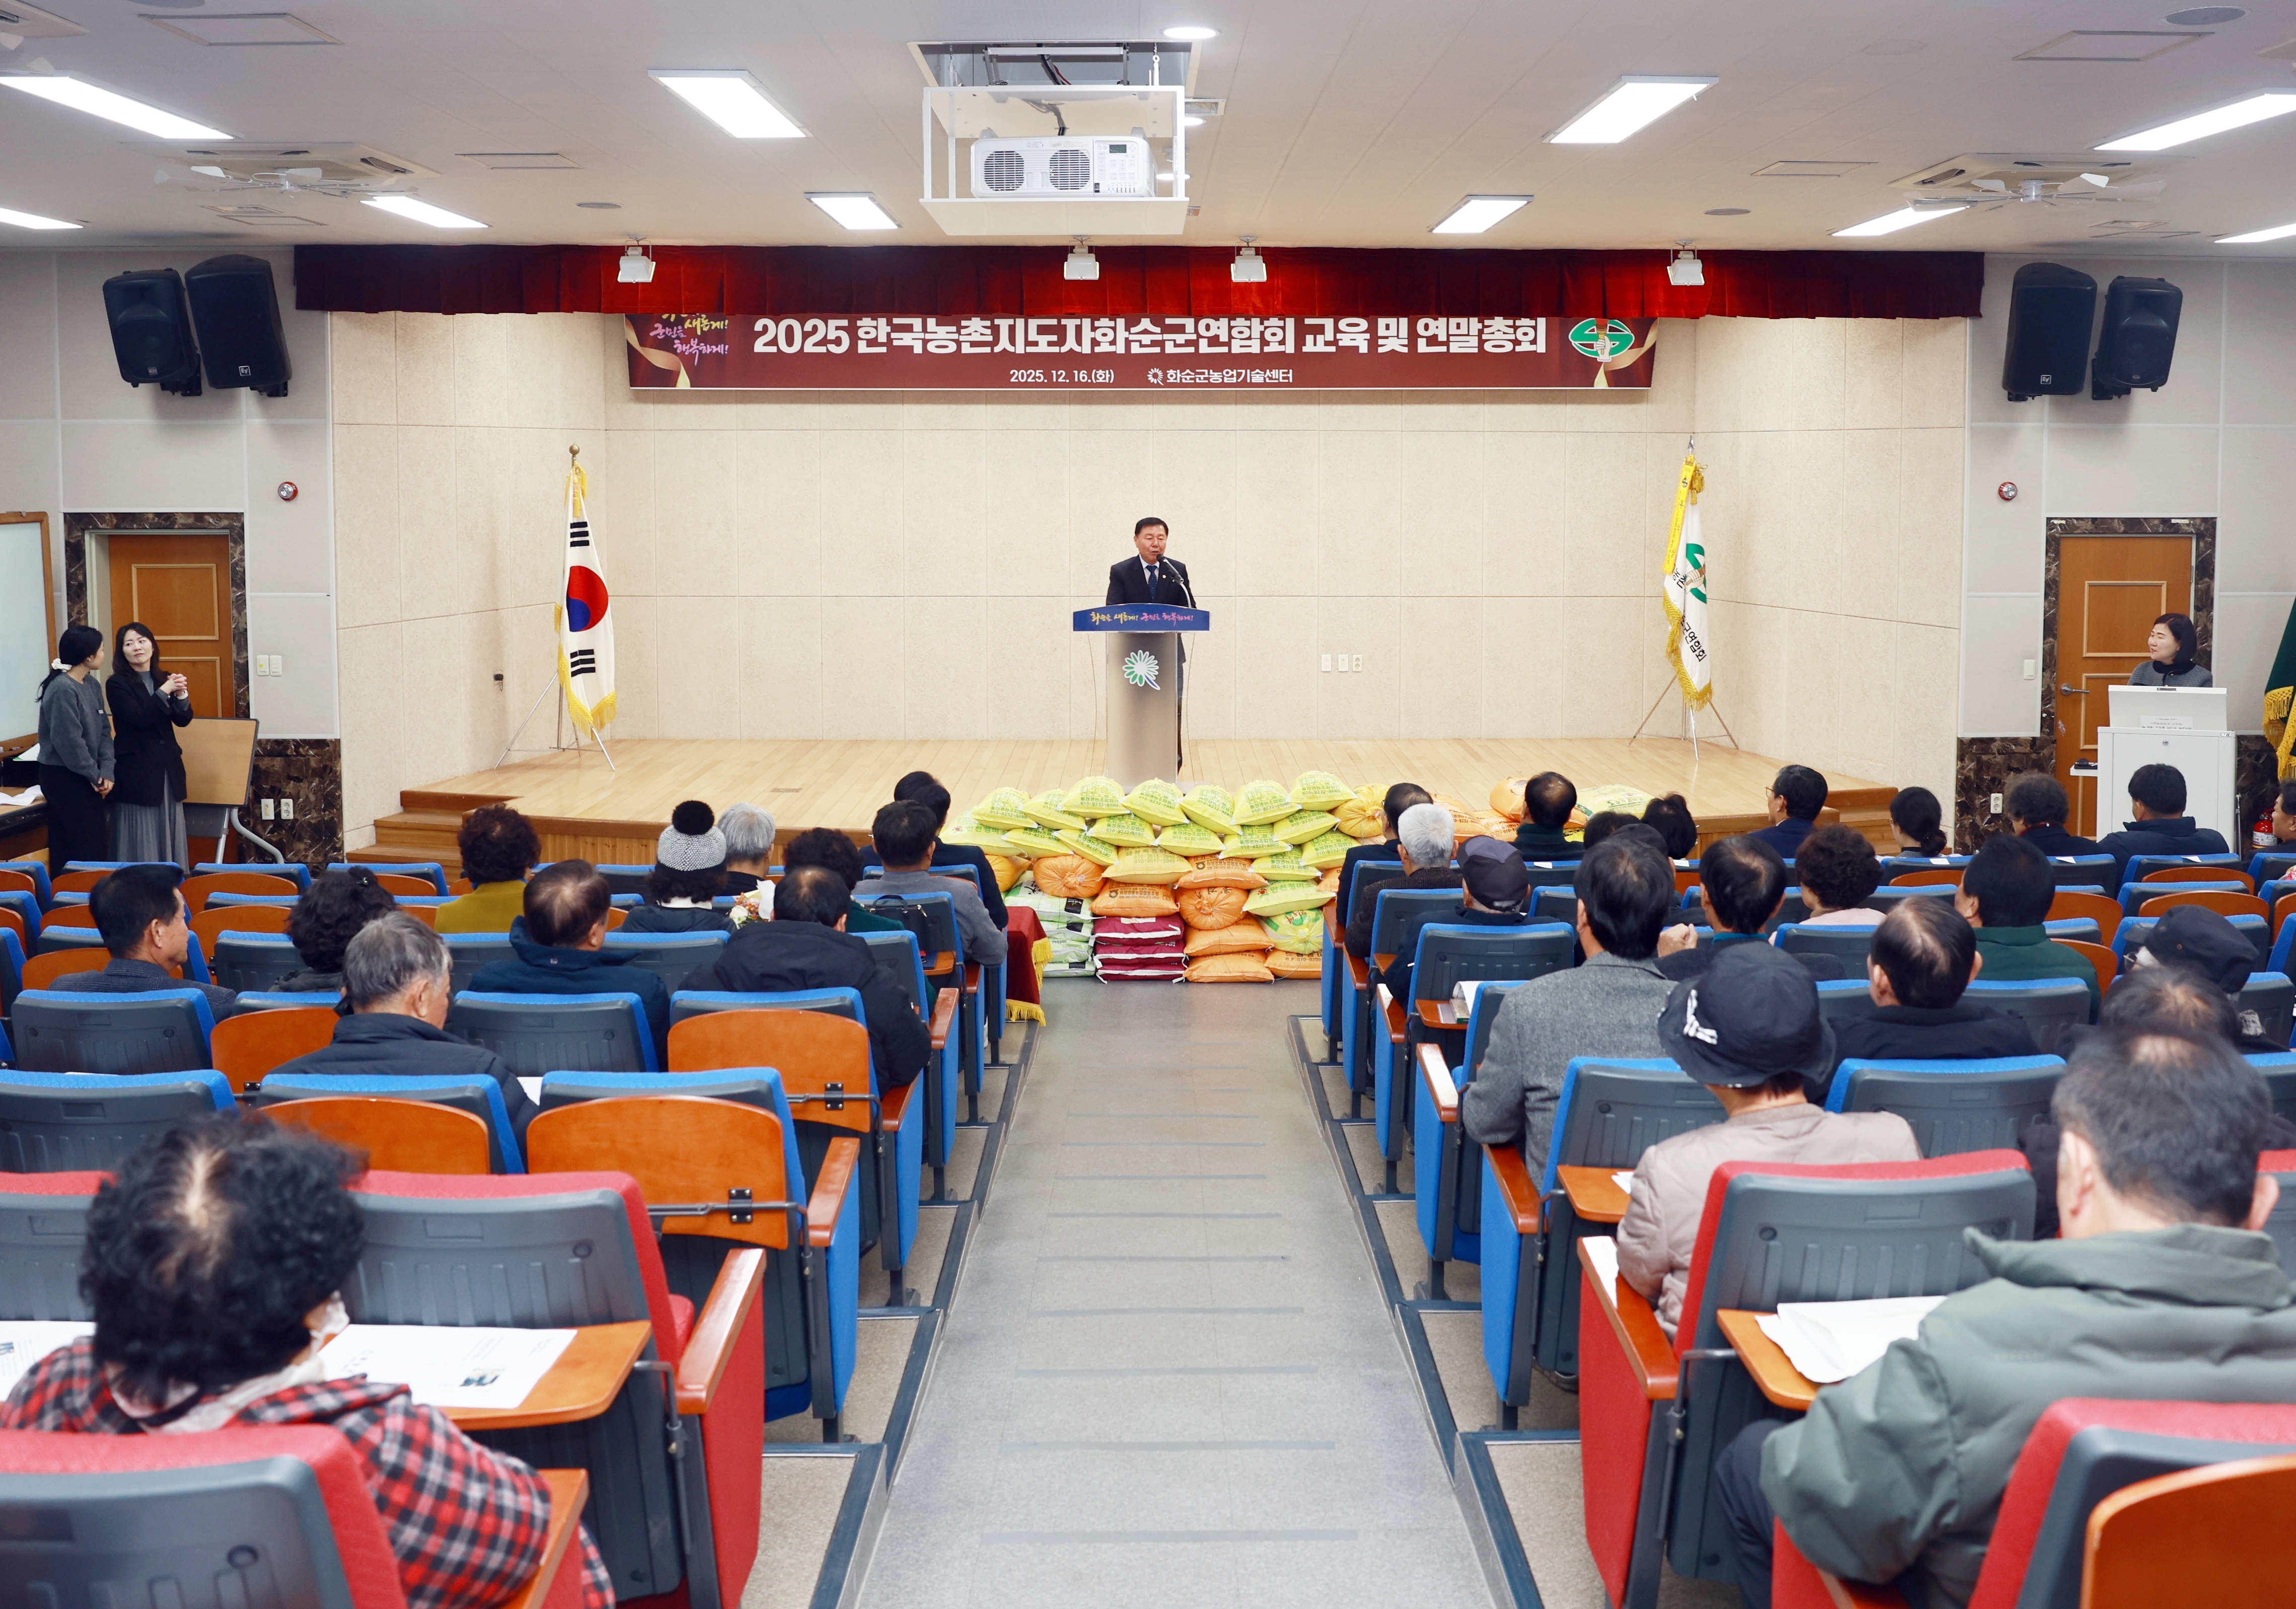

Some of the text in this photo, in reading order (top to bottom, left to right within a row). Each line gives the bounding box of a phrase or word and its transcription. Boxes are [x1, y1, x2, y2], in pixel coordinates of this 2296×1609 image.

[649, 323, 687, 339] 군민을
[754, 317, 1546, 354] 2025 한국농촌지도자화순군연합회 교육 및 연말총회
[673, 338, 729, 366] 행복하게!
[1010, 369, 1114, 383] 2025. 12. 16.(화)
[1166, 369, 1293, 383] 화순군농업기술센터
[1090, 612, 1194, 627] 화순을 새롭게! 군민을 행복하게!
